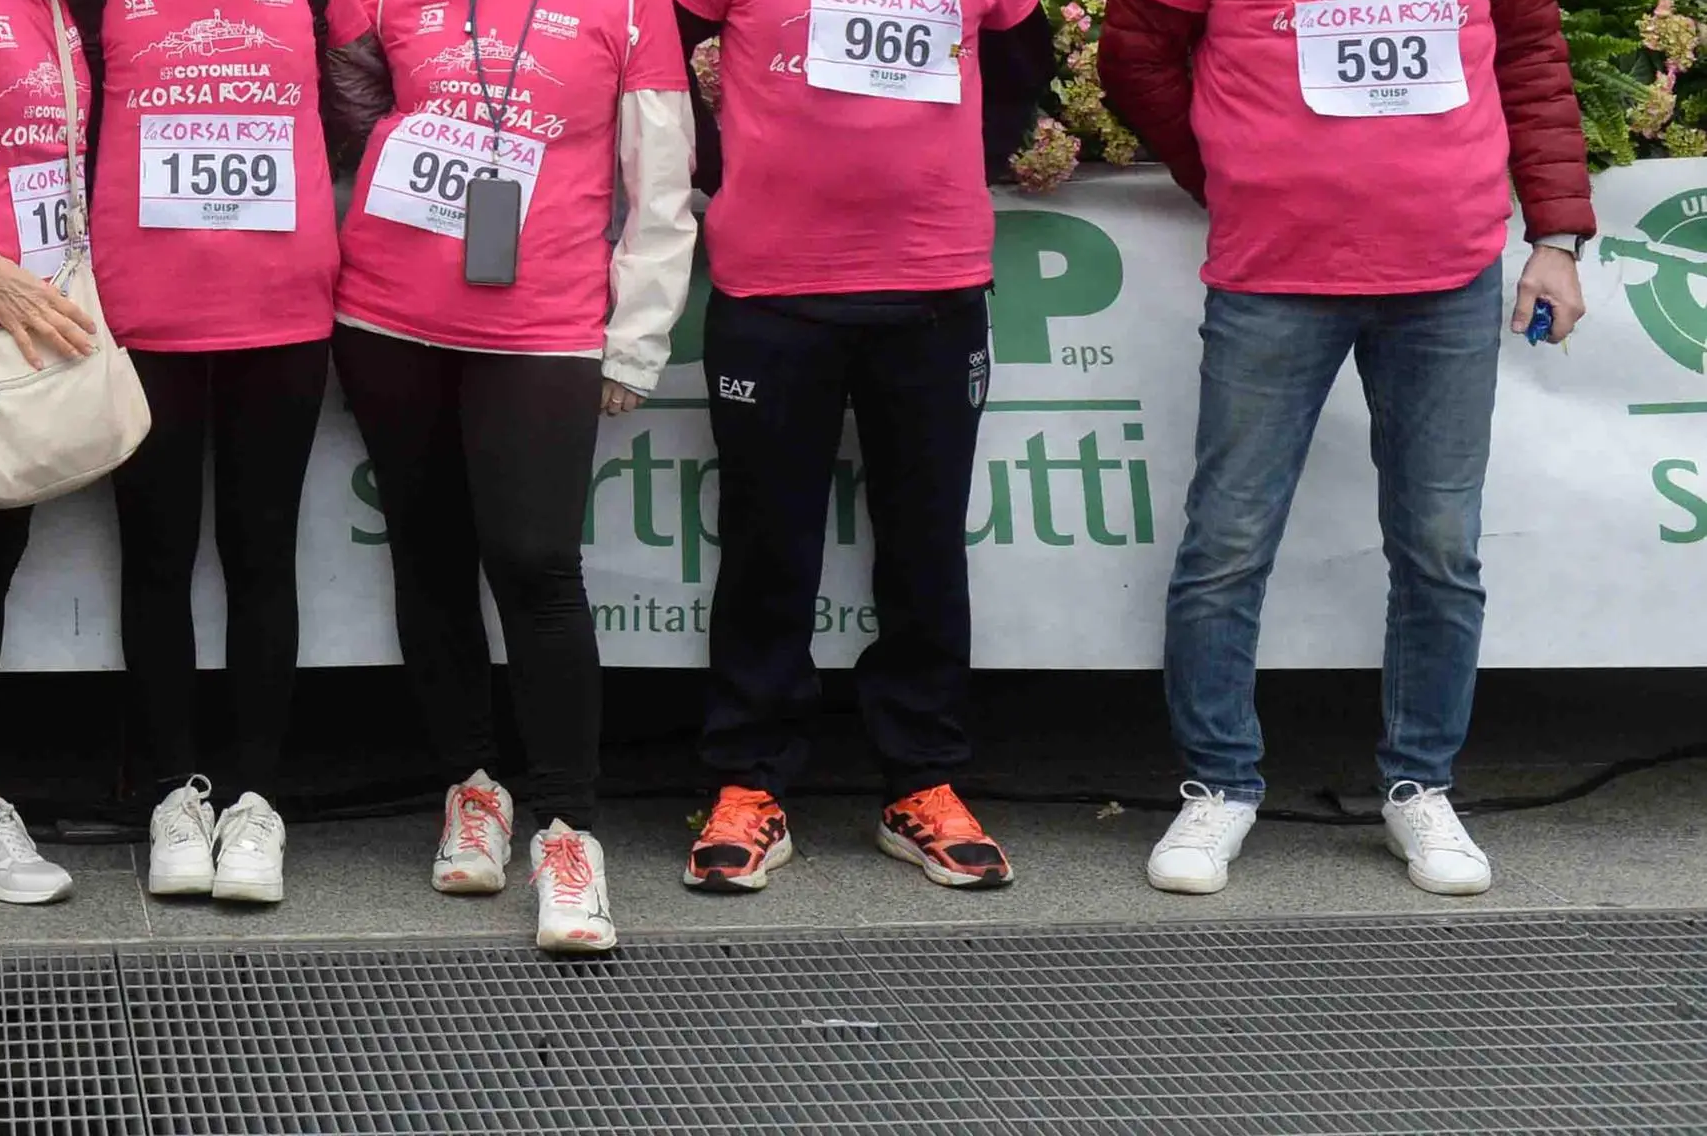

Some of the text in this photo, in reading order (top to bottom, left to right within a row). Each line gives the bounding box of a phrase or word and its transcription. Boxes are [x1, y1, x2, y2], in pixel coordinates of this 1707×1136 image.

[547, 10, 580, 27] UISP
[1316, 5, 1393, 28] CORSA
[1399, 1, 1454, 24] ROSA
[844, 17, 932, 68] 966
[174, 63, 270, 78] COTONELLA
[1336, 35, 1429, 83] 593
[881, 70, 907, 82] UISP
[139, 83, 213, 108] CORSA
[219, 80, 277, 105] ROSA
[277, 83, 302, 107] 26
[1380, 88, 1409, 98] UISP
[1, 123, 54, 147] CORSA
[160, 121, 230, 142] CORSA
[236, 120, 291, 142] ROSA
[408, 119, 475, 148] CORSA
[532, 113, 568, 139] 26
[161, 152, 278, 197] 1569
[213, 203, 239, 213] UISP
[1060, 344, 1115, 370] aps
[719, 375, 756, 398] EA7
